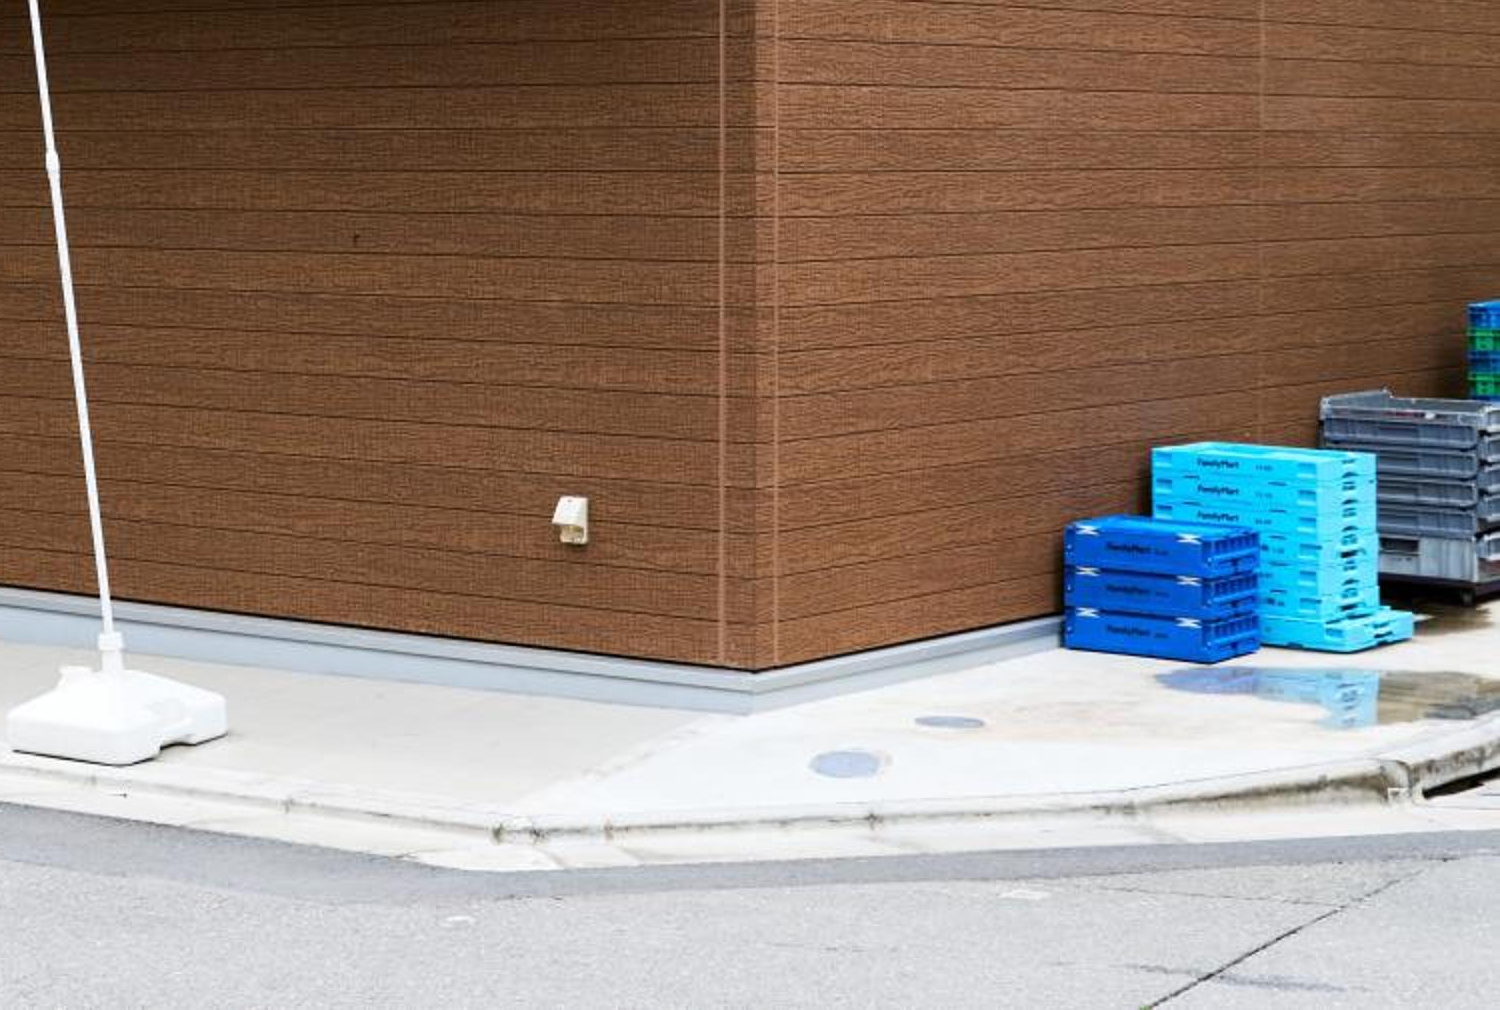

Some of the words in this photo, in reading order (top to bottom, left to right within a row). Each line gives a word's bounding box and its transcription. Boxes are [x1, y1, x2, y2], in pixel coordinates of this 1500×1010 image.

[1197, 457, 1239, 470] FamilyMart
[1197, 484, 1239, 497] FamilyMart
[1197, 510, 1239, 523] FamilyMart
